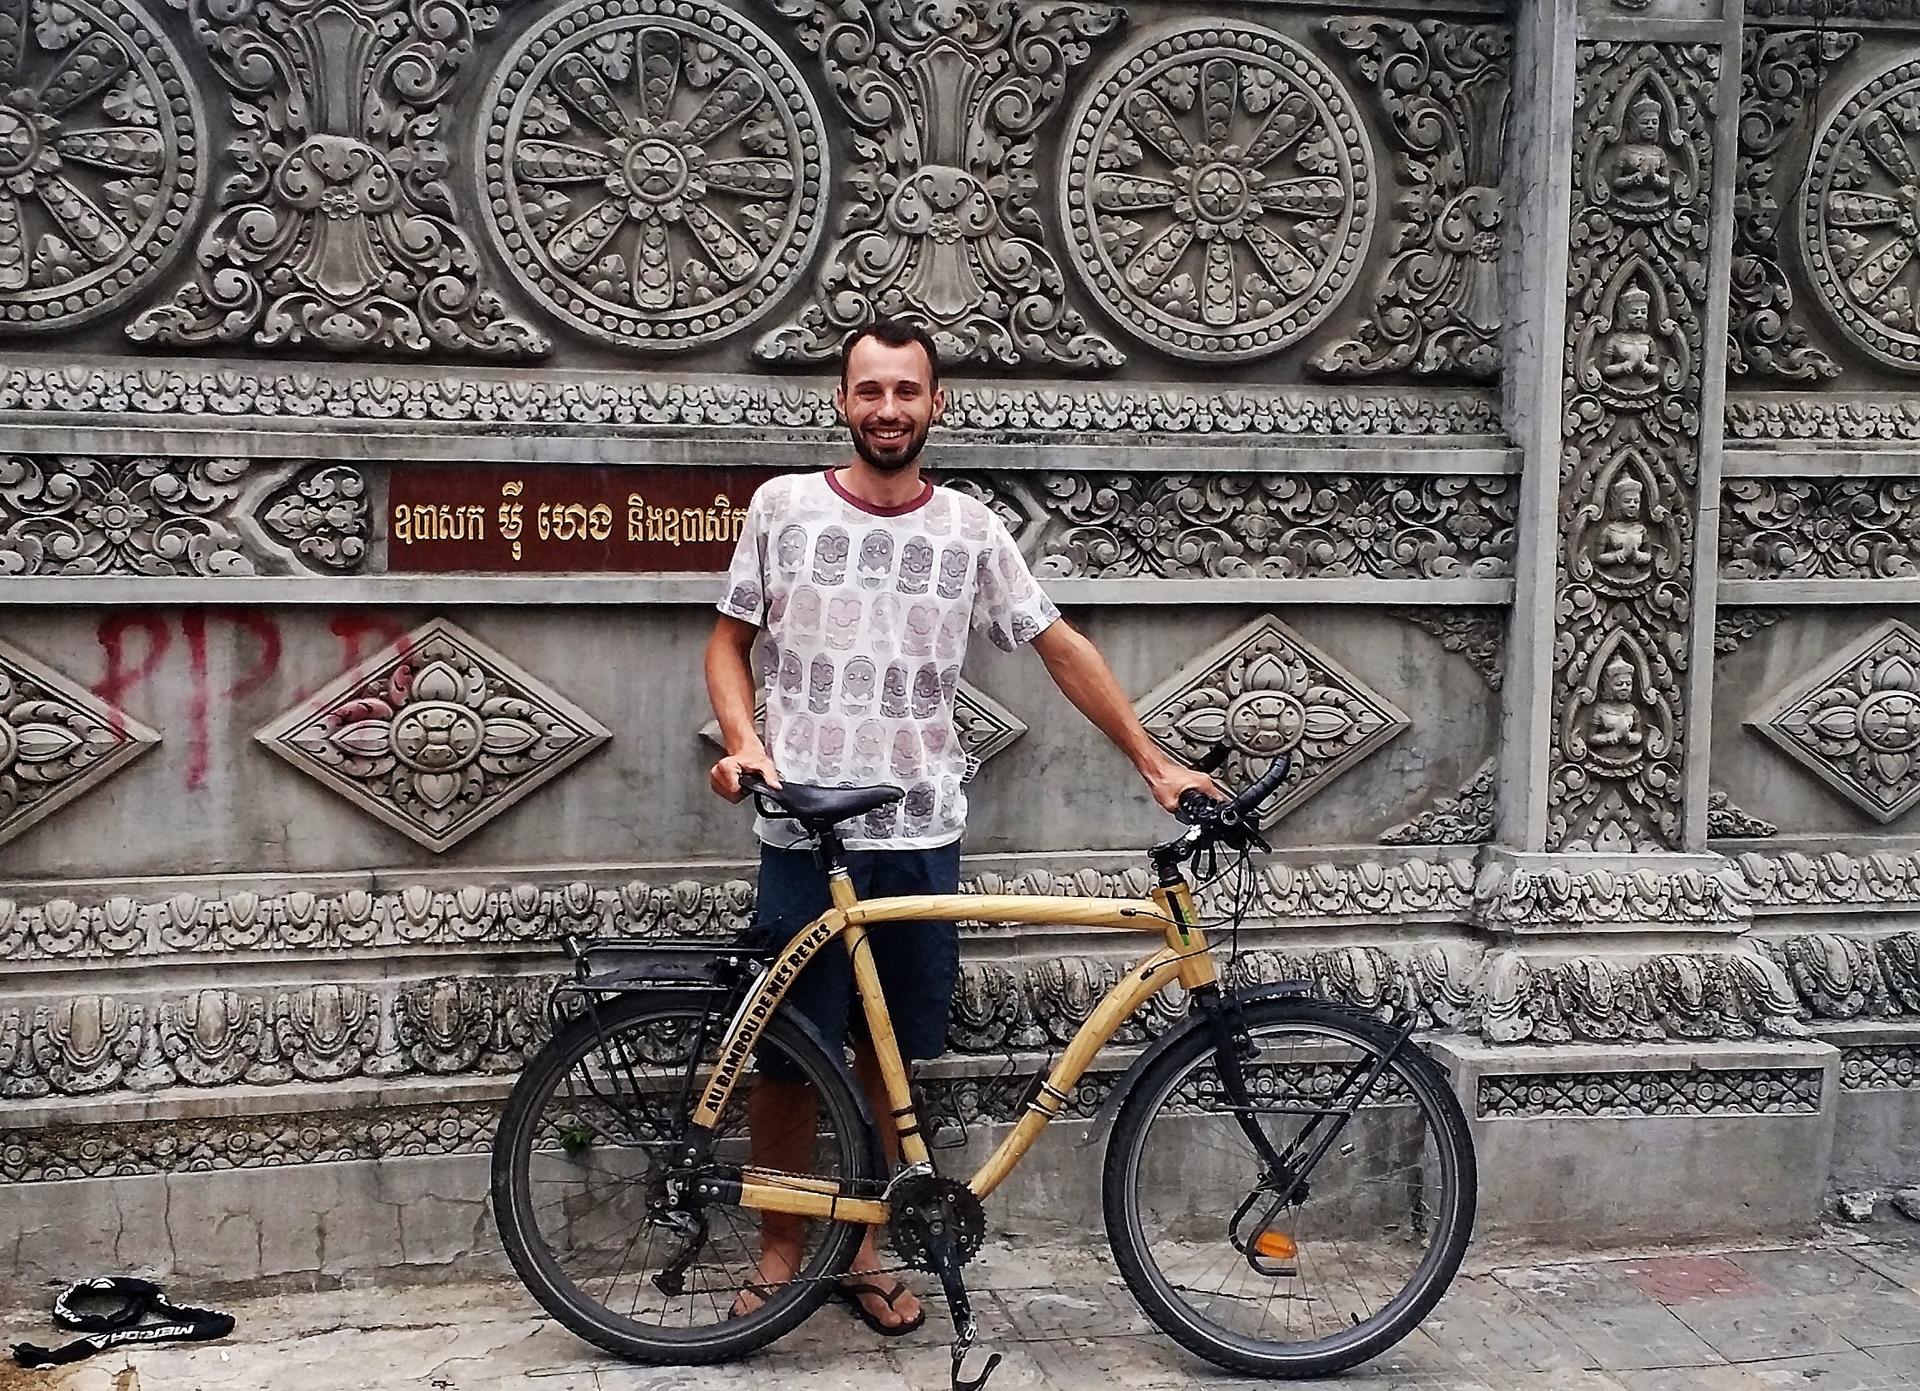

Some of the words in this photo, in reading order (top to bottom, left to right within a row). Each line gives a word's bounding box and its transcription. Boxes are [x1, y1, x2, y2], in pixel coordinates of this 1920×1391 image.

[705, 1085, 725, 1113] AU
[716, 1018, 759, 1088] BAMBOU
[752, 996, 773, 1021] DE
[765, 967, 794, 998] MES
[788, 923, 832, 969] REVES
[110, 1324, 195, 1344] MERIDA
